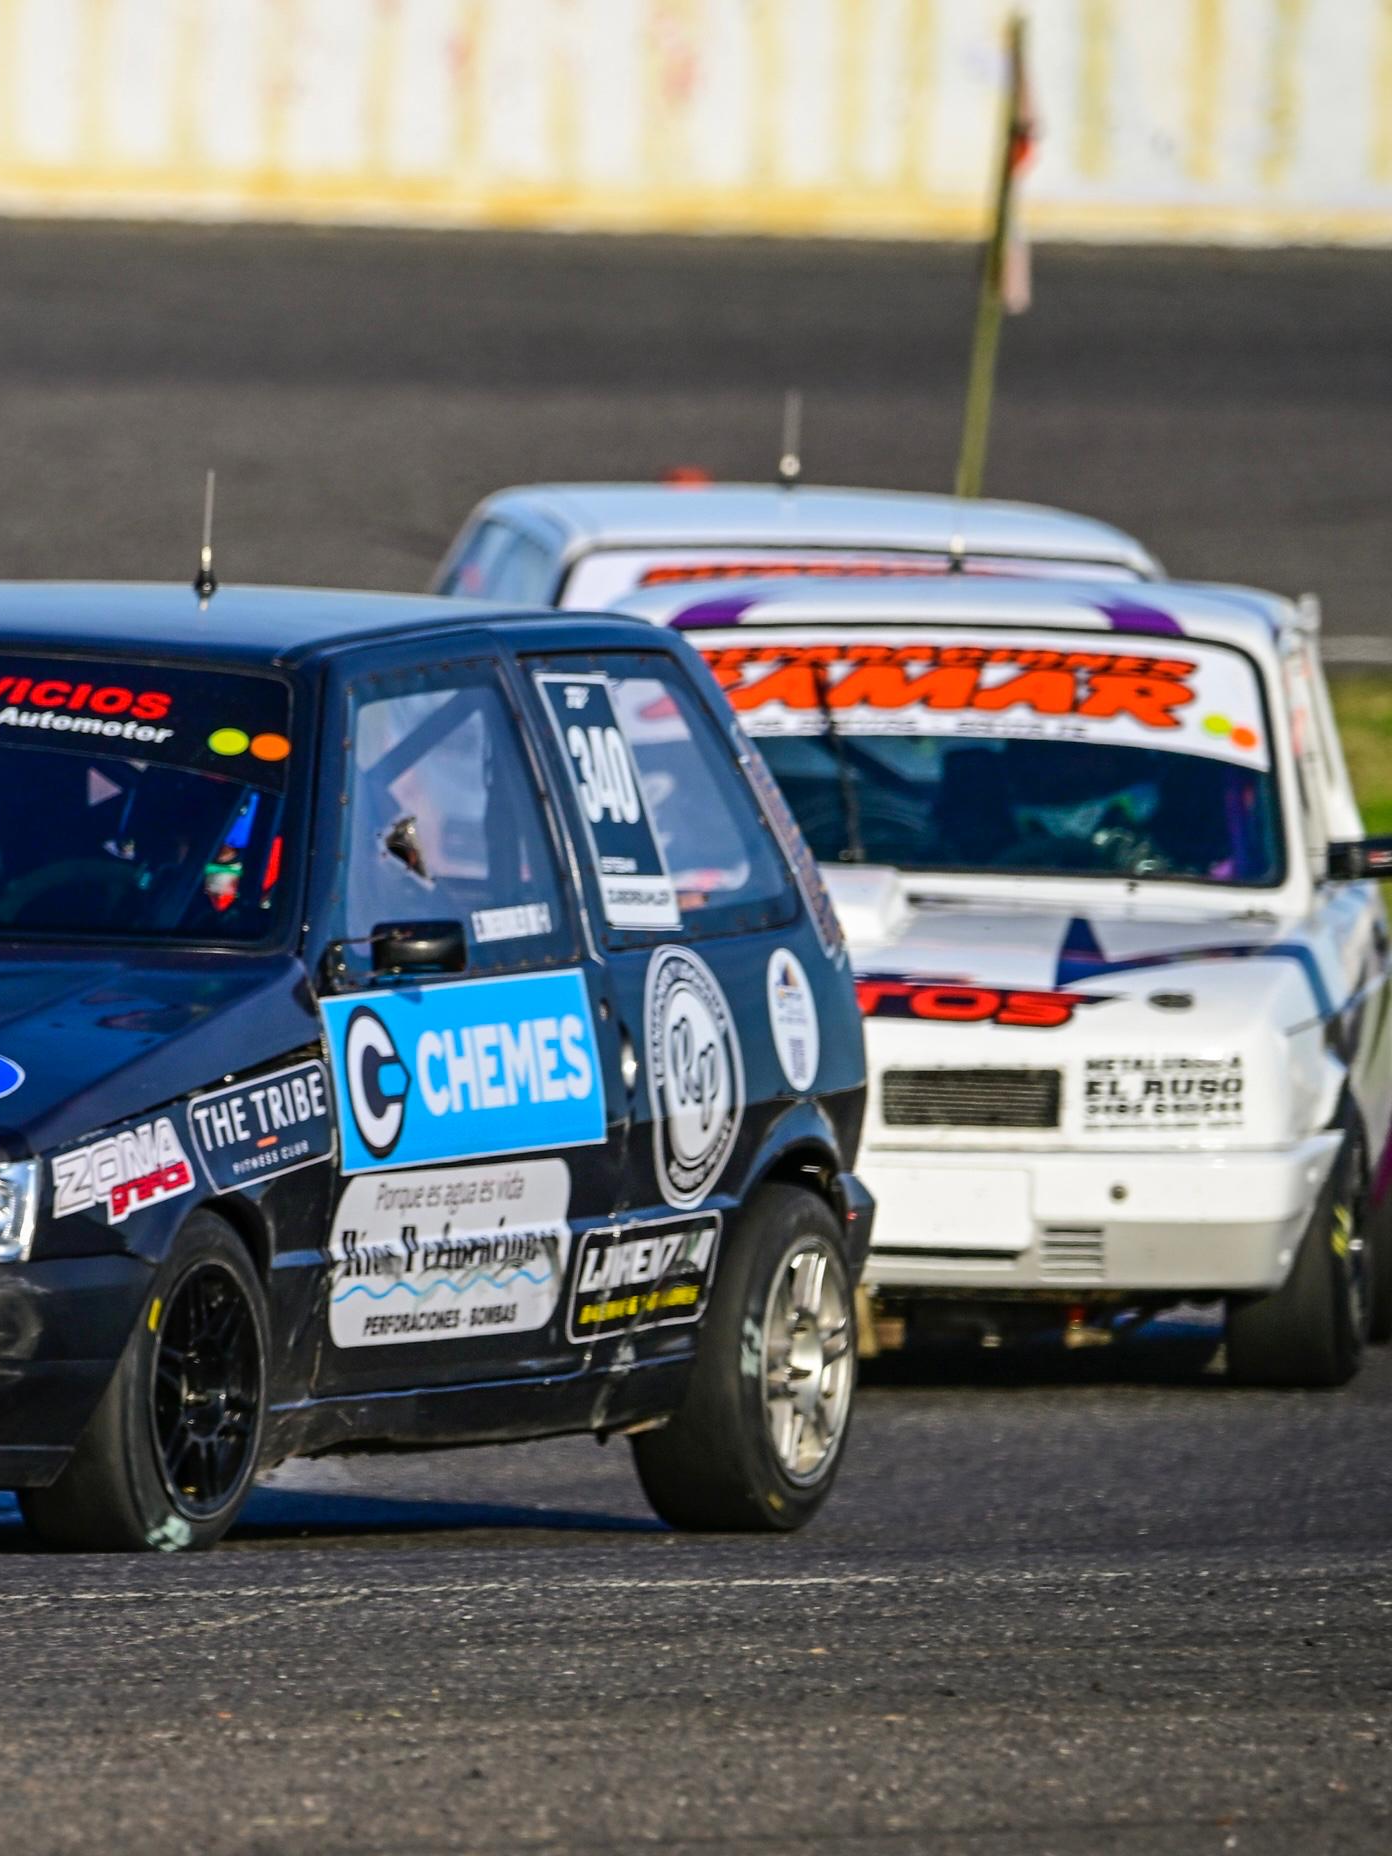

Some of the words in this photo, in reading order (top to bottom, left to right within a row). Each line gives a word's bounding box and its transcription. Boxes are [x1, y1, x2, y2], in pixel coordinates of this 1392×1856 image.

[699, 644, 1198, 680] EPARACIONES
[567, 725, 641, 824] 340
[416, 1013, 593, 1117] CHEMES
[1143, 1077, 1243, 1100] RUSO
[193, 1096, 251, 1151] THE
[249, 1070, 327, 1134] TRIBE
[55, 1119, 187, 1213] ZONA
[232, 1148, 280, 1176] FITNESS
[280, 1138, 309, 1161] CLUB
[375, 1182, 424, 1216] Porque
[426, 1185, 441, 1208] es
[445, 1181, 476, 1215] agua
[479, 1179, 496, 1204] es
[497, 1169, 525, 1202] vida
[363, 1308, 459, 1337] PERFORACIONES
[469, 1303, 518, 1328] BOMBAS
